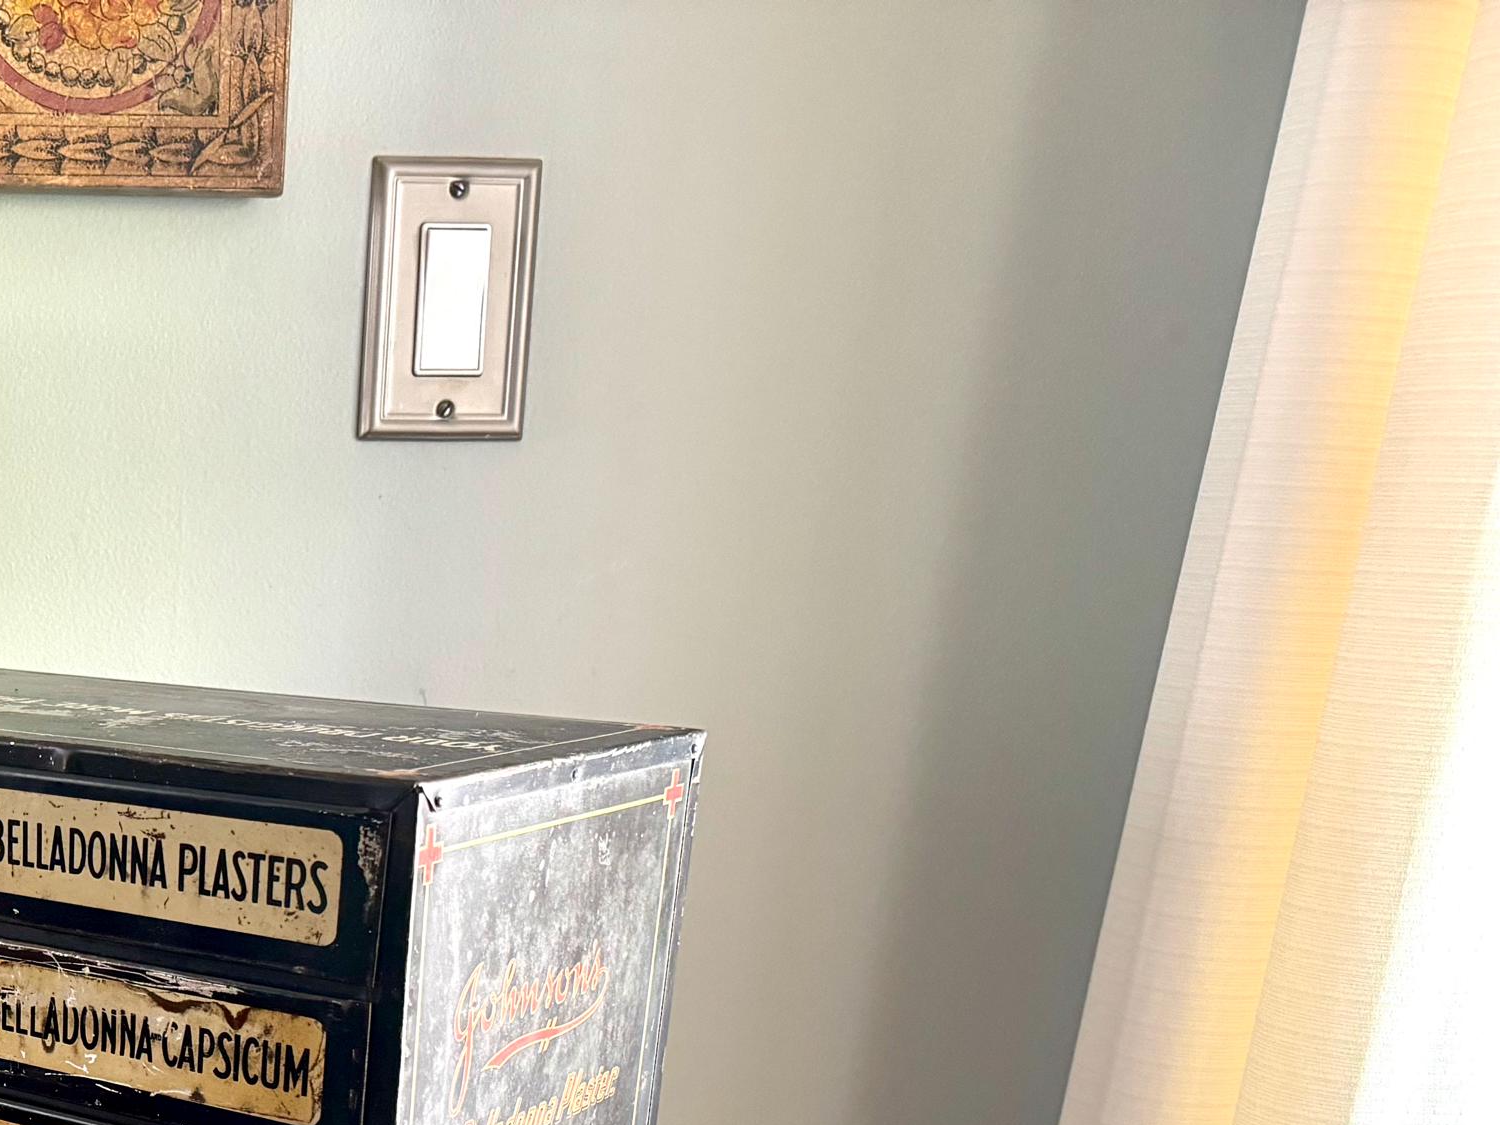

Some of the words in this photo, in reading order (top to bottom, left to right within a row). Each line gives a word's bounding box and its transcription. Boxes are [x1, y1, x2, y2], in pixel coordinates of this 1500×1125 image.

[381, 735, 501, 752] YOUR
[178, 842, 328, 915] PLASTERS
[161, 1021, 311, 1097] CAPSICUM
[448, 938, 610, 1119] Johnson's
